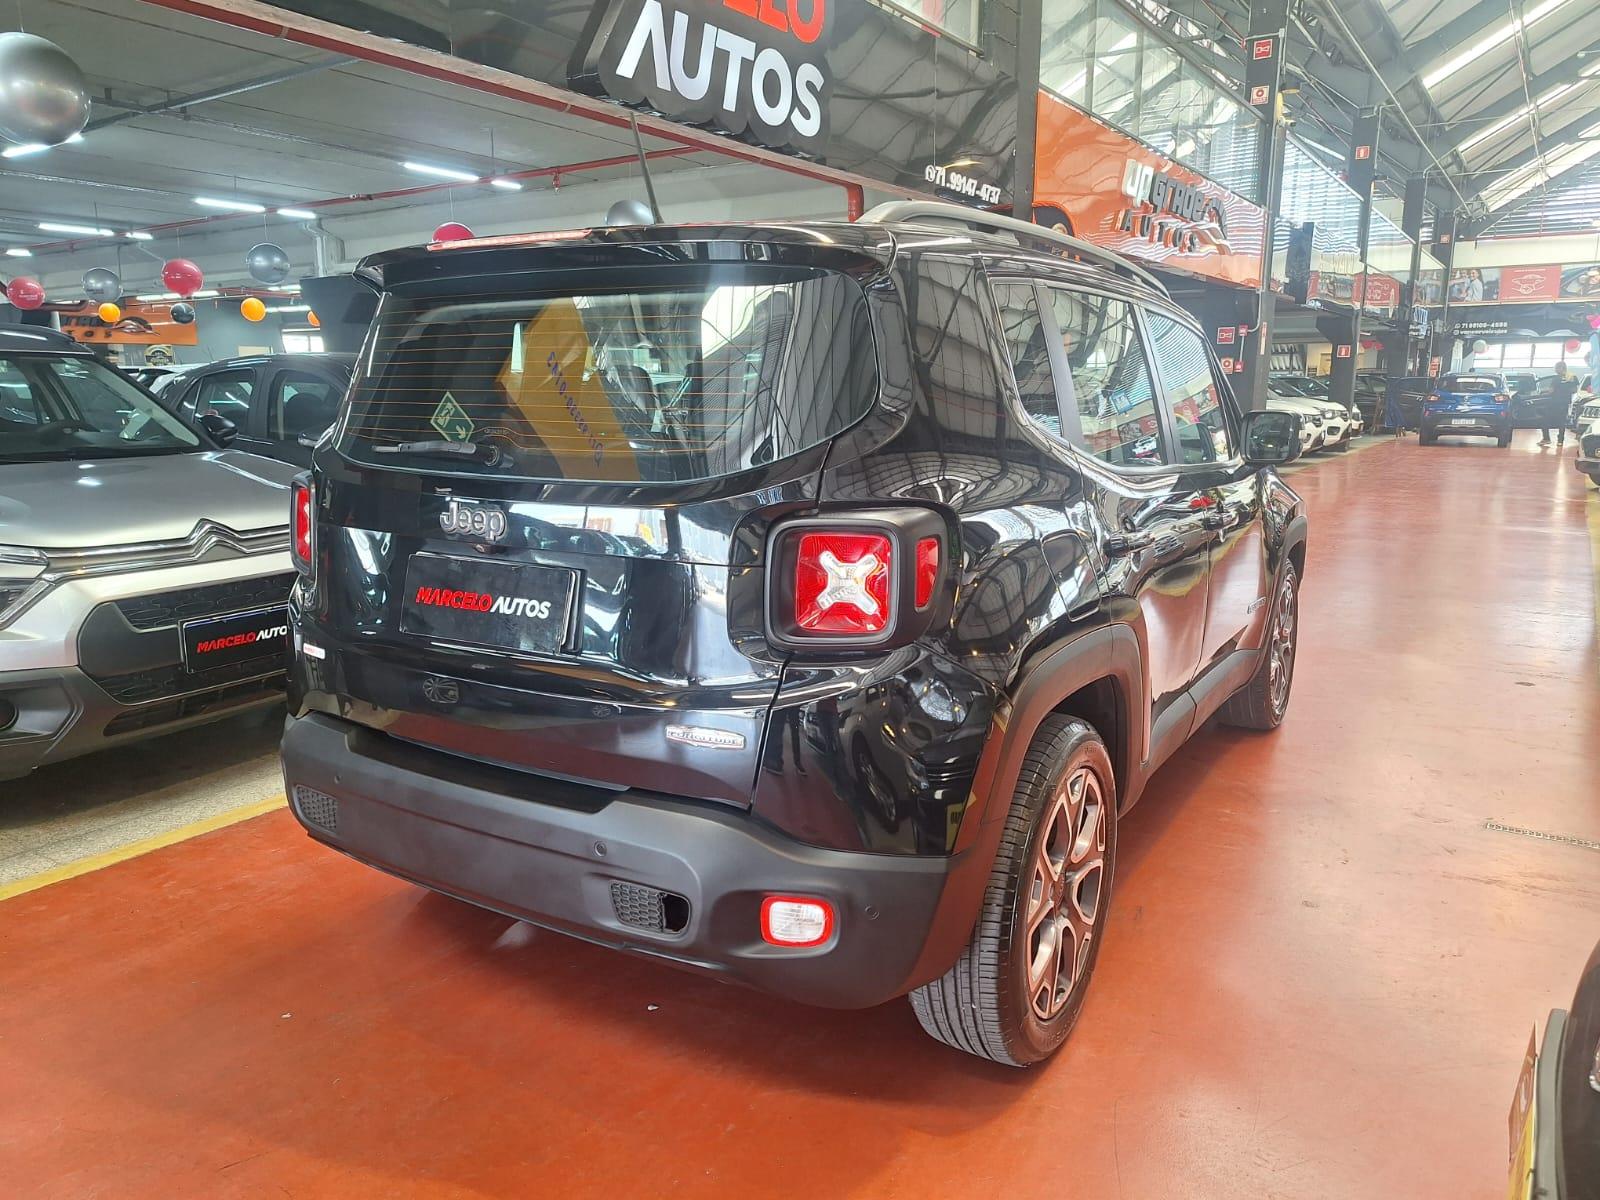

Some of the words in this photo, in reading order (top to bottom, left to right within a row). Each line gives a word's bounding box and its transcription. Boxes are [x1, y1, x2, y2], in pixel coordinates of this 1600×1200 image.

[616, 0, 824, 137] AUTOS
[440, 501, 507, 542] Jeep
[415, 586, 493, 613] MARCELO
[490, 596, 552, 619] AUTOS
[197, 631, 257, 654] MARCELO
